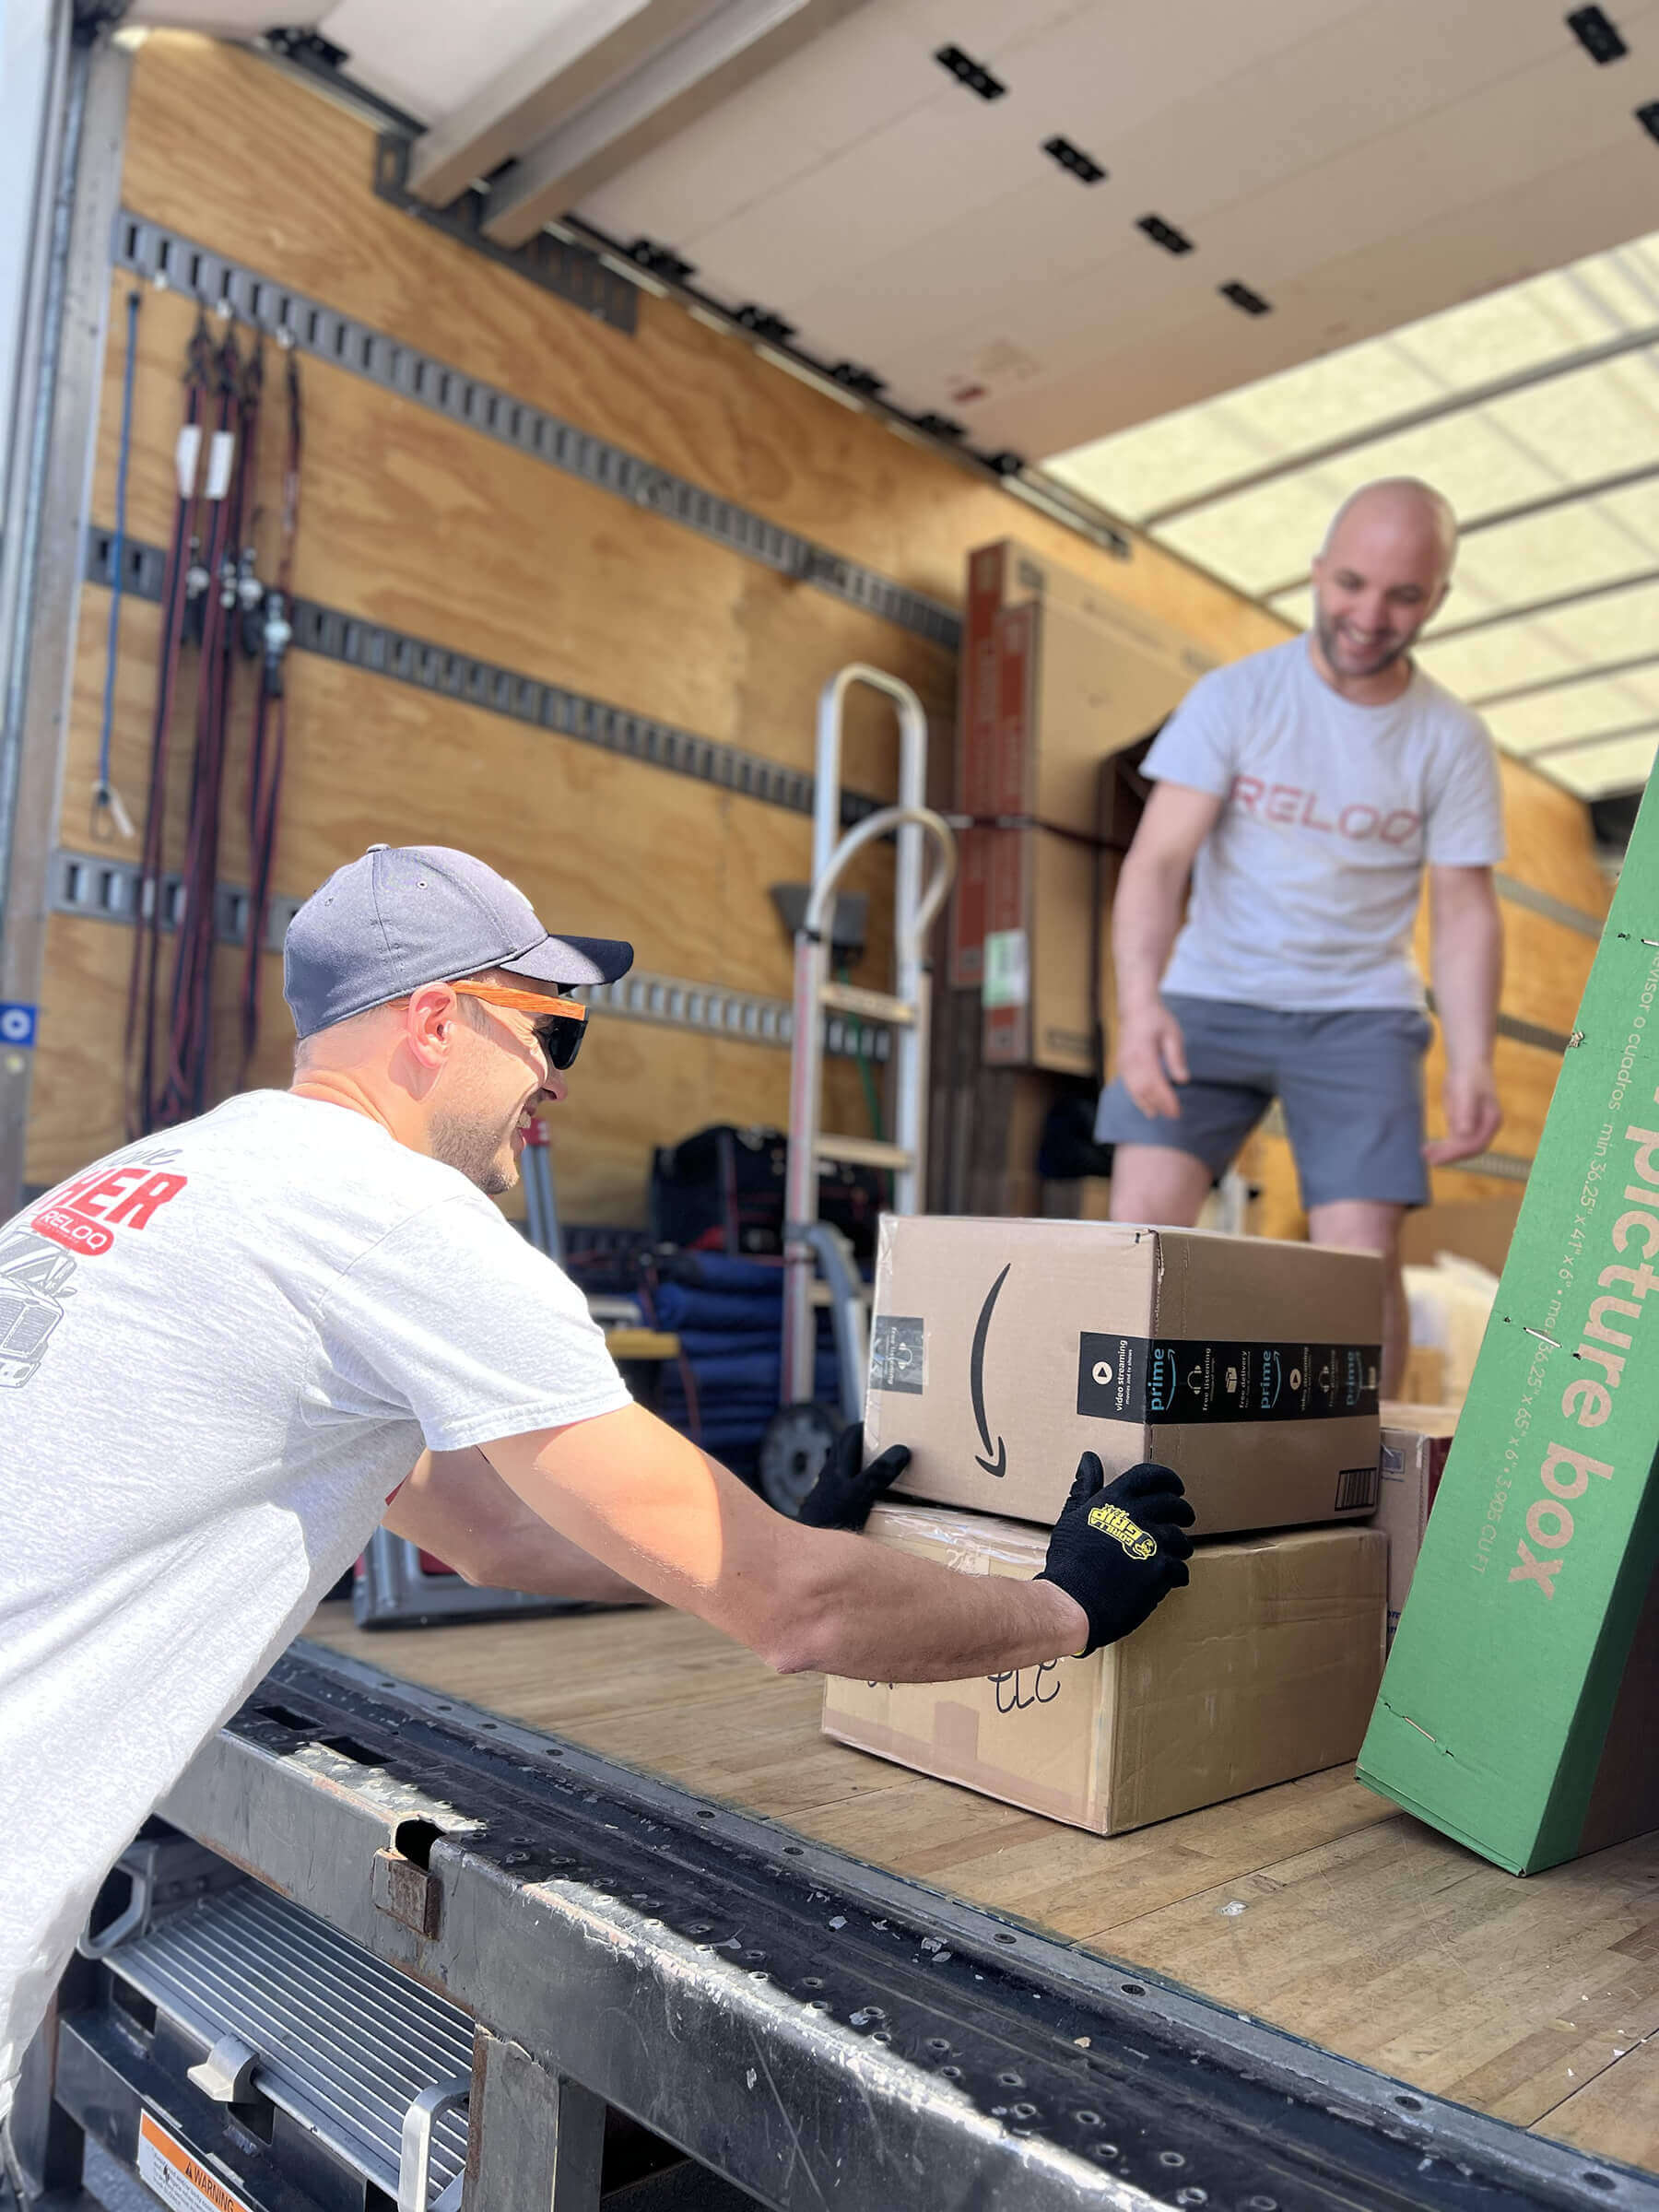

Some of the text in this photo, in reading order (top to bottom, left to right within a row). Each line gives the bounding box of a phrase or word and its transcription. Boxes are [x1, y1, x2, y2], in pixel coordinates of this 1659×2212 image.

[1638, 951, 1659, 1013] evisor
[1633, 1017, 1646, 1029] o
[1608, 1033, 1641, 1111] cuadros
[1594, 1124, 1614, 1158] min
[1581, 1159, 1607, 1215] 36.25"
[1573, 1214, 1587, 1226] x
[1568, 1228, 1586, 1254] 41"
[1562, 1254, 1575, 1266] x
[1114, 1339, 1128, 1411] video streaming
[1147, 1348, 1165, 1410] prime
[1260, 1350, 1271, 1408] prime
[1507, 1125, 1659, 1601] picture box
[1521, 1394, 1534, 1406] x
[1508, 1437, 1520, 1447] x
[1091, 1509, 1143, 1540] GRIP
[1477, 1524, 1498, 1551] CU
[194, 2166, 234, 2212] WARNING
